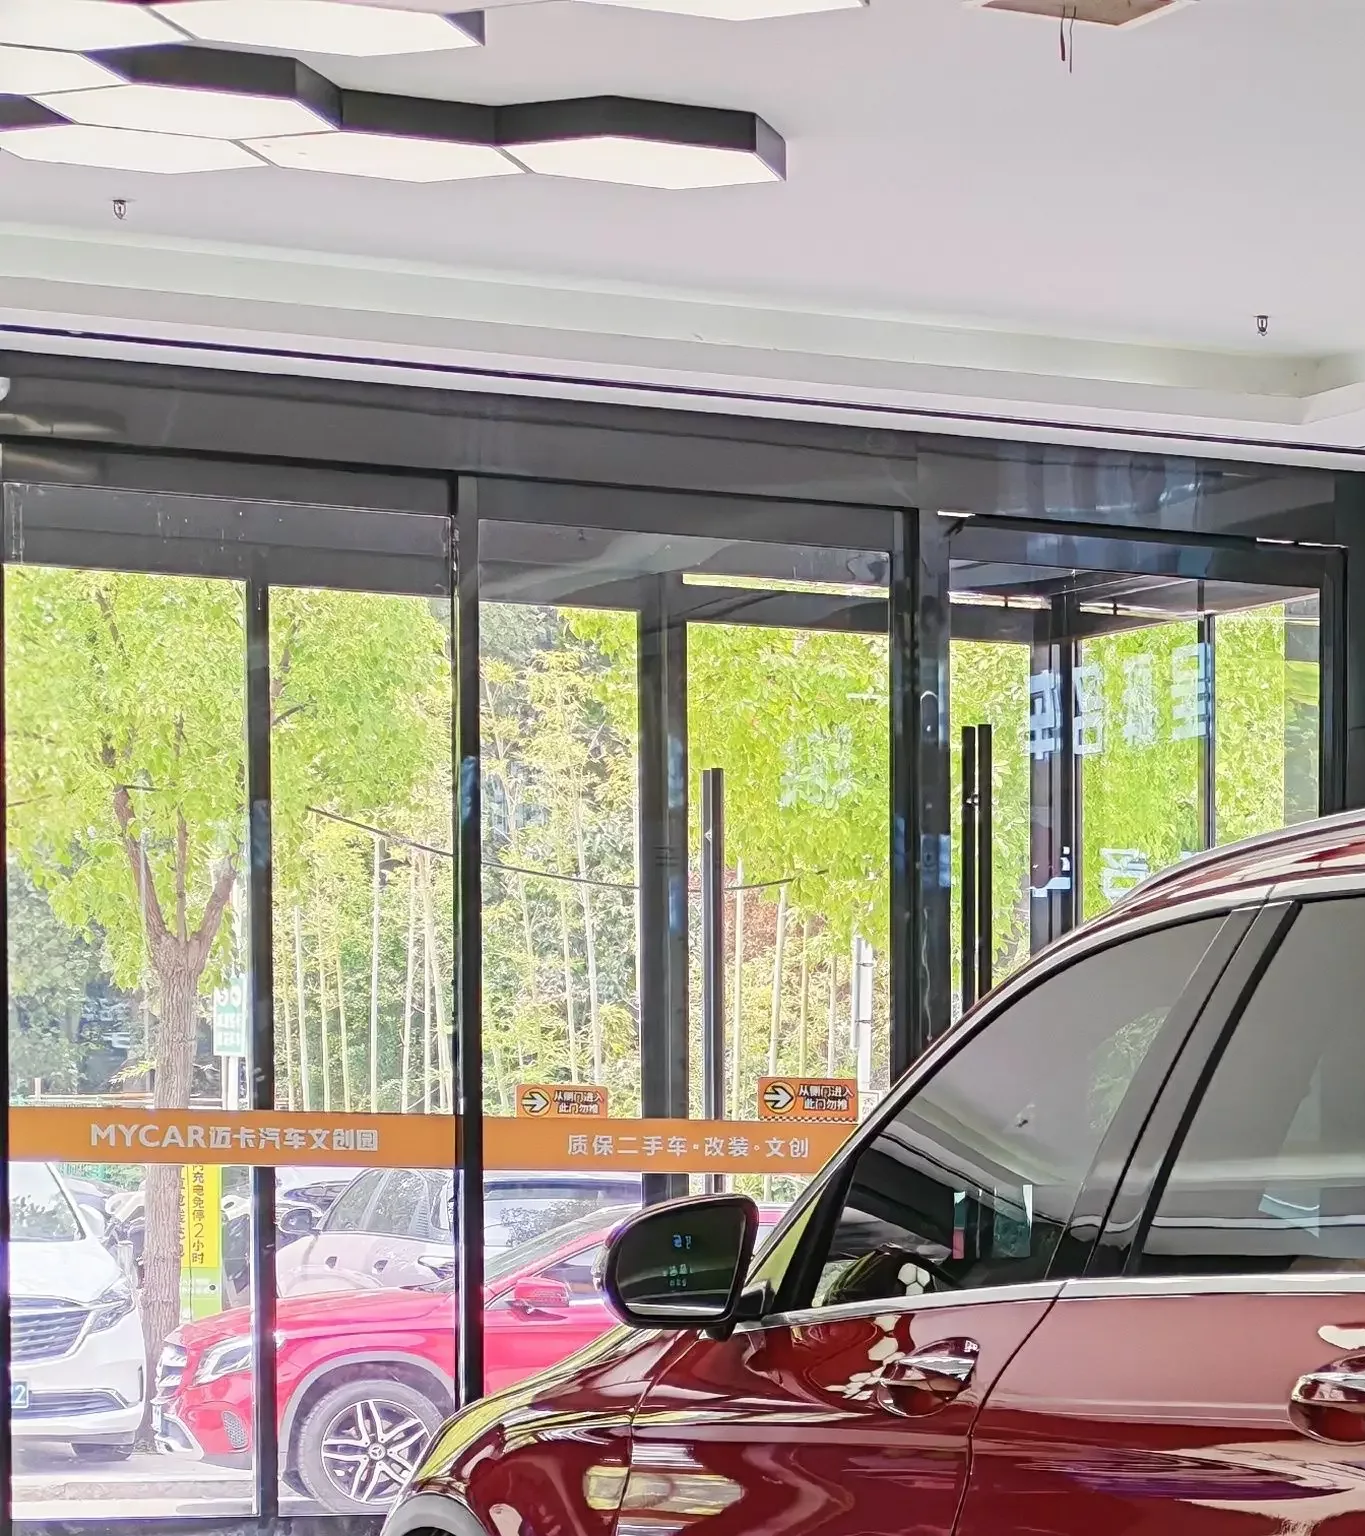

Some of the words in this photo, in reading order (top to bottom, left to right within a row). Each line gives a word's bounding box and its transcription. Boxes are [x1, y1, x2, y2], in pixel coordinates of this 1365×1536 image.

[553, 1088, 604, 1103] 从侧门进入
[798, 1084, 854, 1100] 从侧门进入
[803, 1098, 848, 1112] 此门勿推
[90, 1124, 378, 1151] MYCAR迈卡汽车文创园
